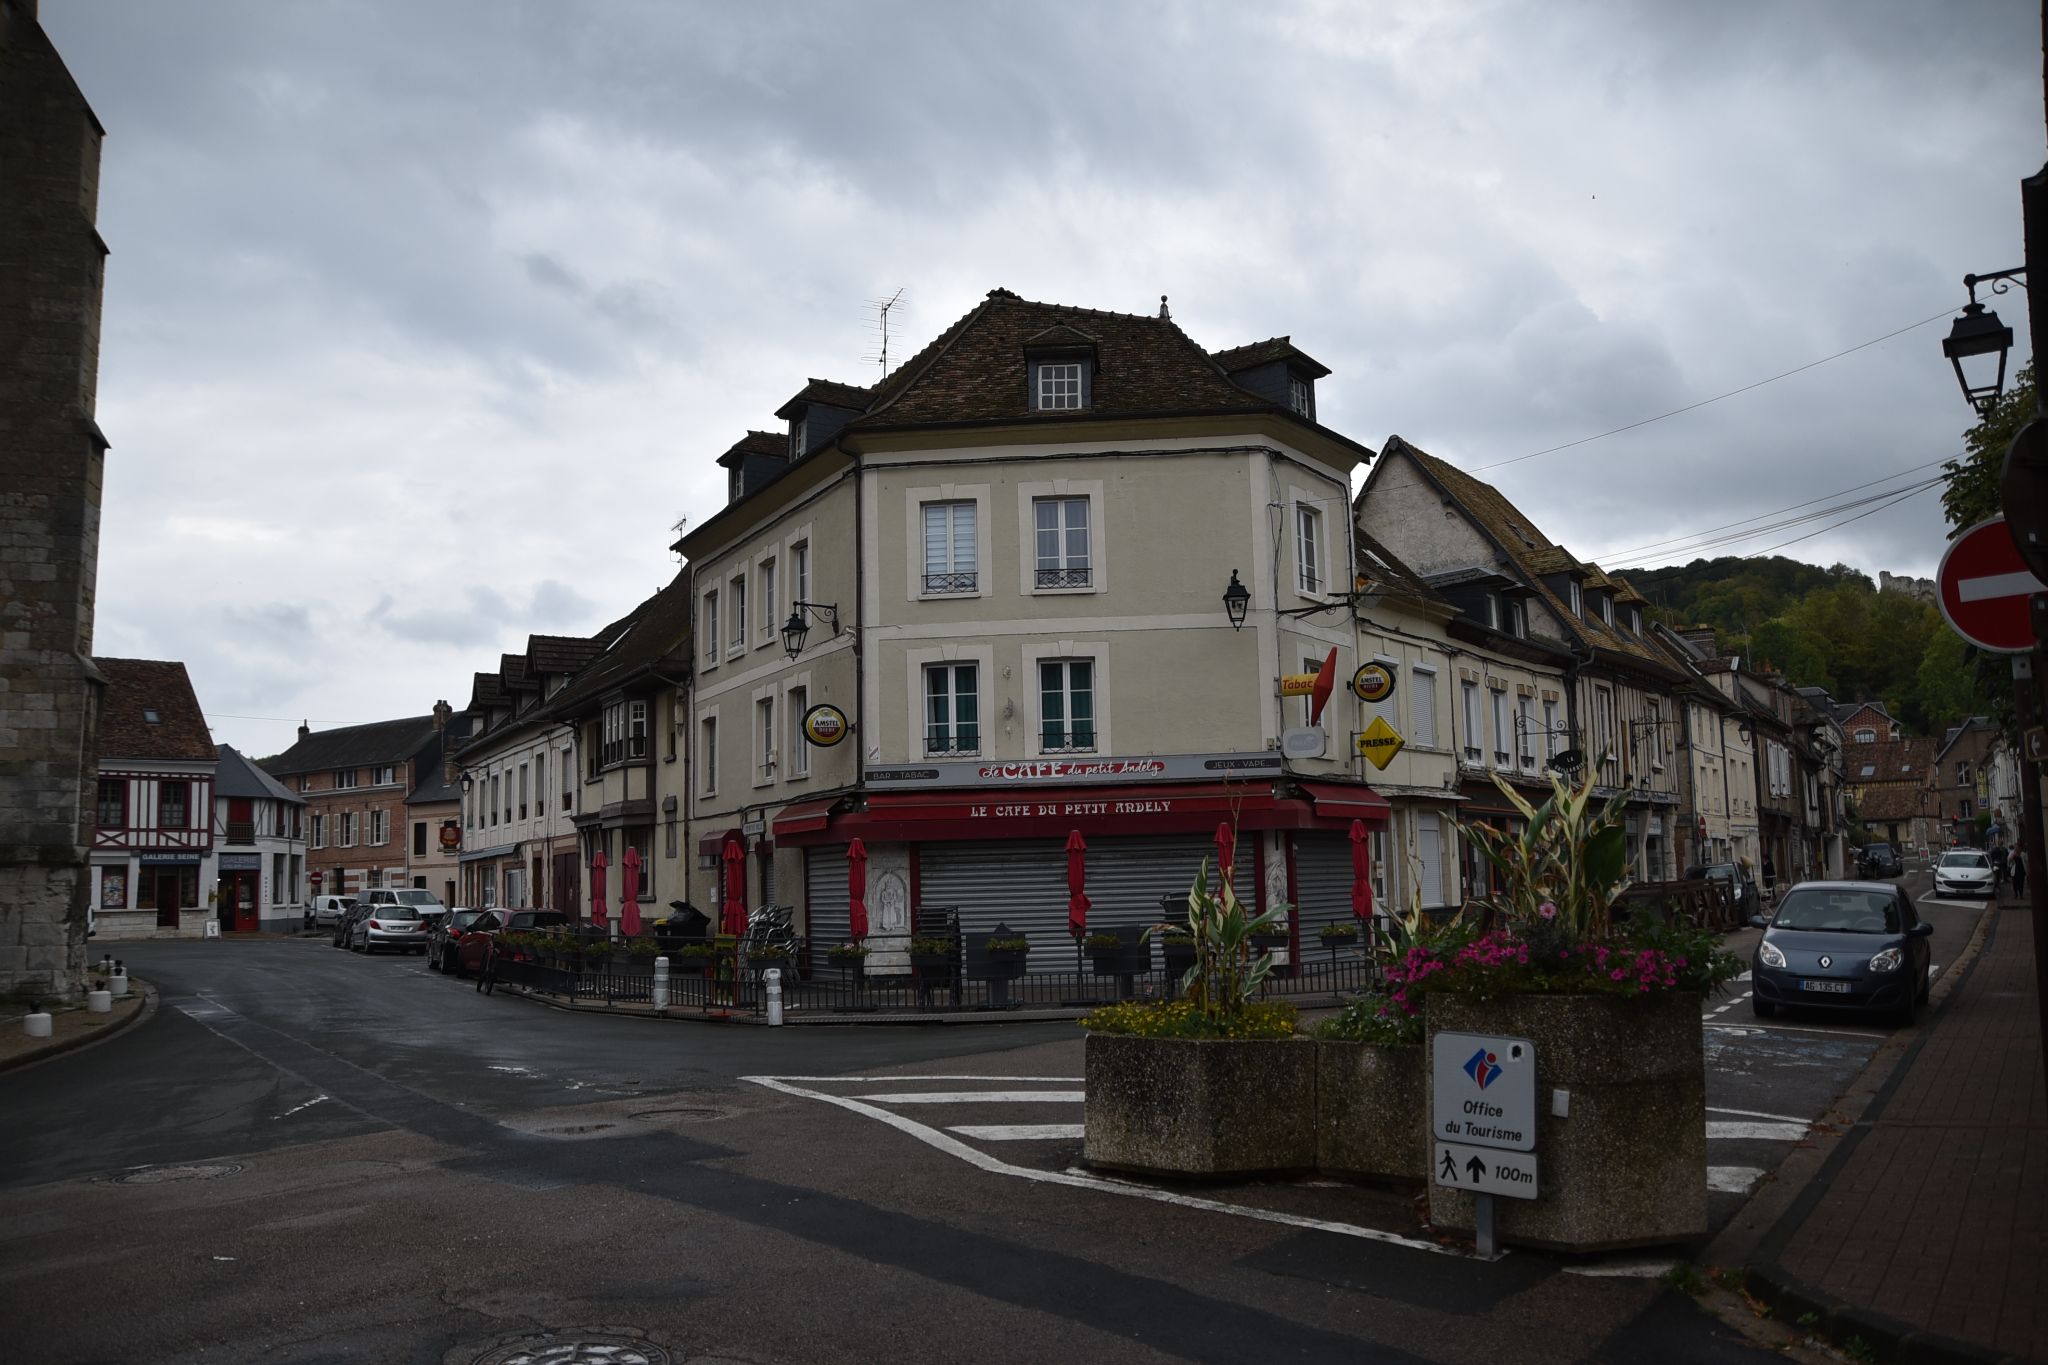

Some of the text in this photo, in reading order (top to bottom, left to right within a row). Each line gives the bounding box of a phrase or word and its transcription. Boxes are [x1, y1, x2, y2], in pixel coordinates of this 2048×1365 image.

[1282, 679, 1313, 690] Tabac
[1360, 737, 1396, 748] PRESSE
[982, 765, 999, 778] Le
[1067, 763, 1082, 775] du
[1085, 763, 1114, 777] petit
[1118, 760, 1162, 776] Andely
[1213, 761, 1235, 769] JEUX
[873, 772, 891, 780] BAR
[900, 771, 929, 779] TABAC
[971, 801, 1171, 817] LE CAFE DU PETIT ANDELY
[222, 855, 257, 864] GALERIE
[1464, 1100, 1503, 1118] Office
[1445, 1120, 1522, 1142] du Tourisme
[1495, 1165, 1533, 1184] 100m
